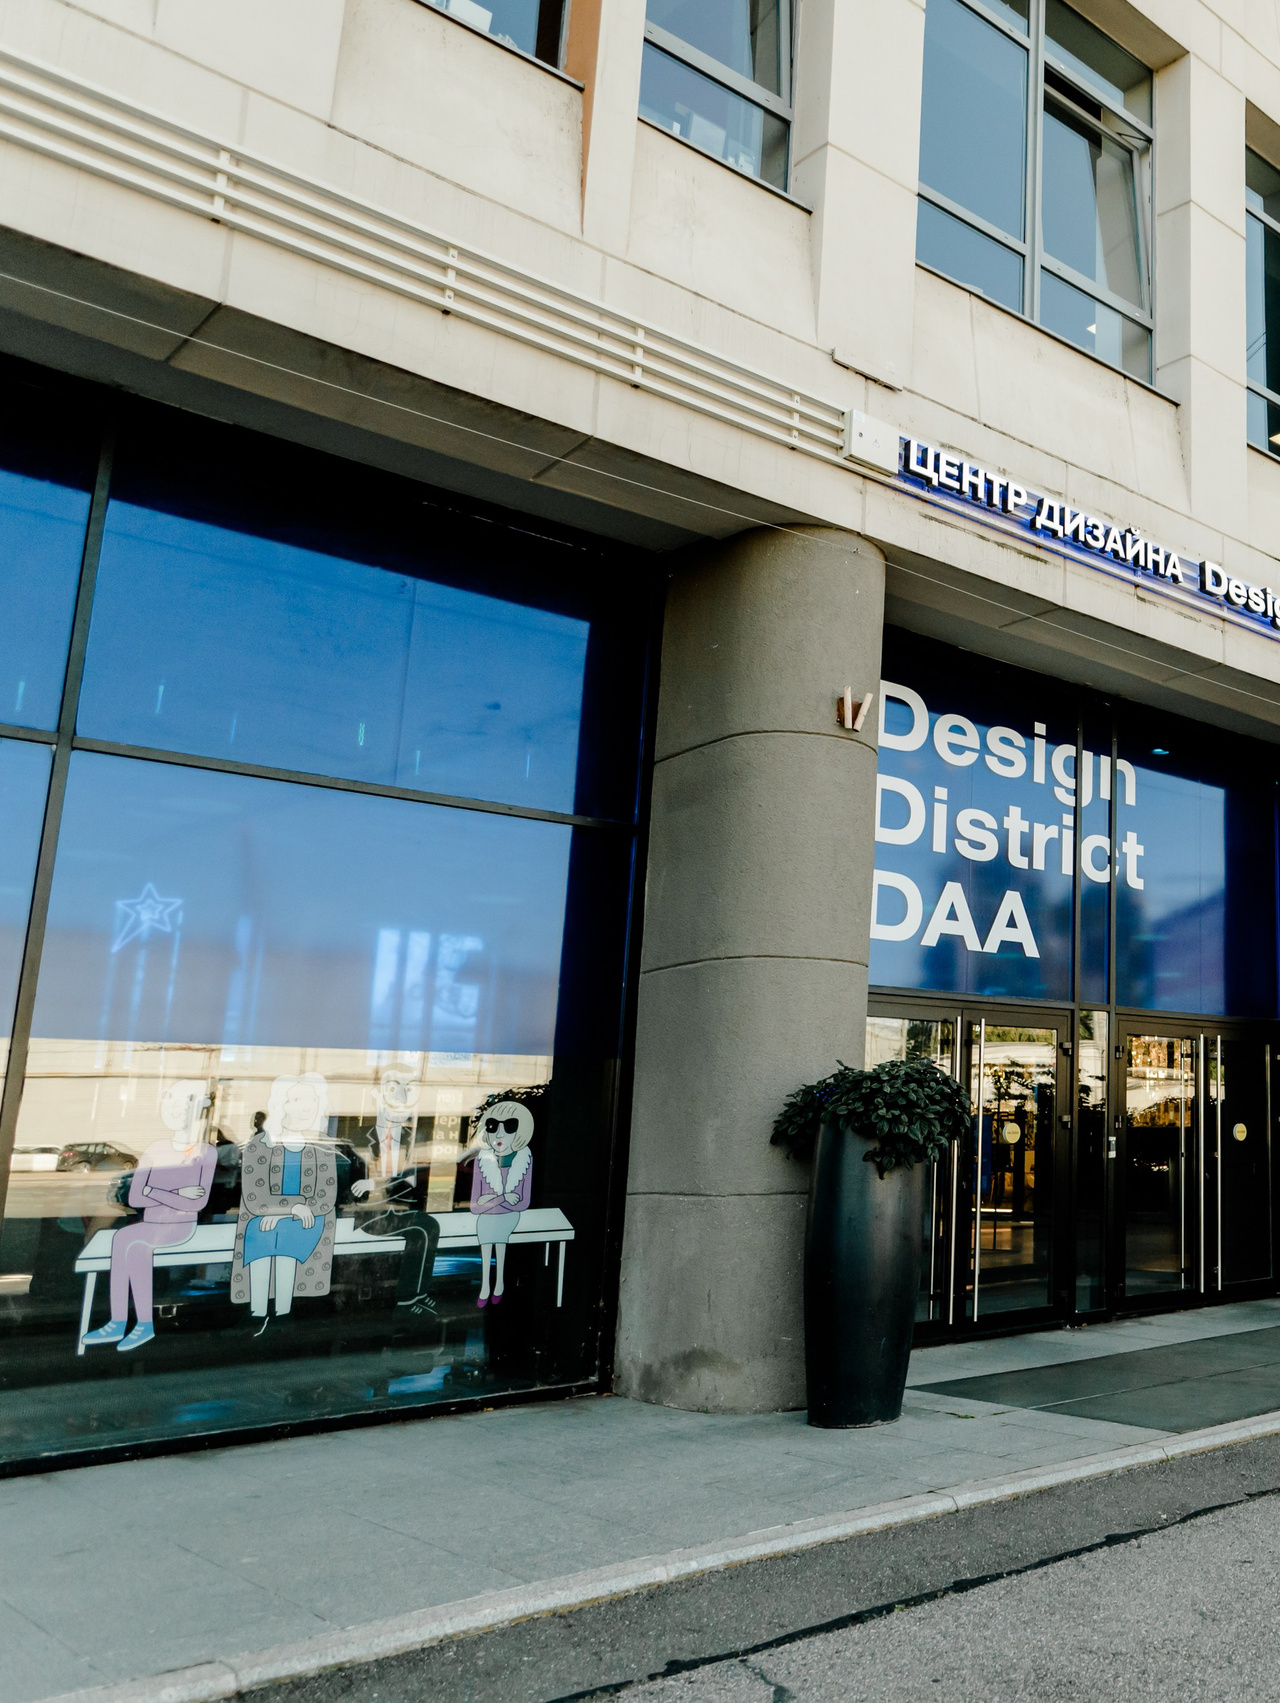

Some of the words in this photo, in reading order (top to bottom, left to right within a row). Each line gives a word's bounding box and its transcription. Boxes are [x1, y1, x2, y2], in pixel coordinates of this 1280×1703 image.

[907, 440, 1028, 514] ЦЕНТР
[1035, 498, 1184, 583] ДИЗАЙНА
[877, 679, 1137, 807] Design
[874, 773, 1145, 891] District
[869, 869, 1040, 959] DAA
